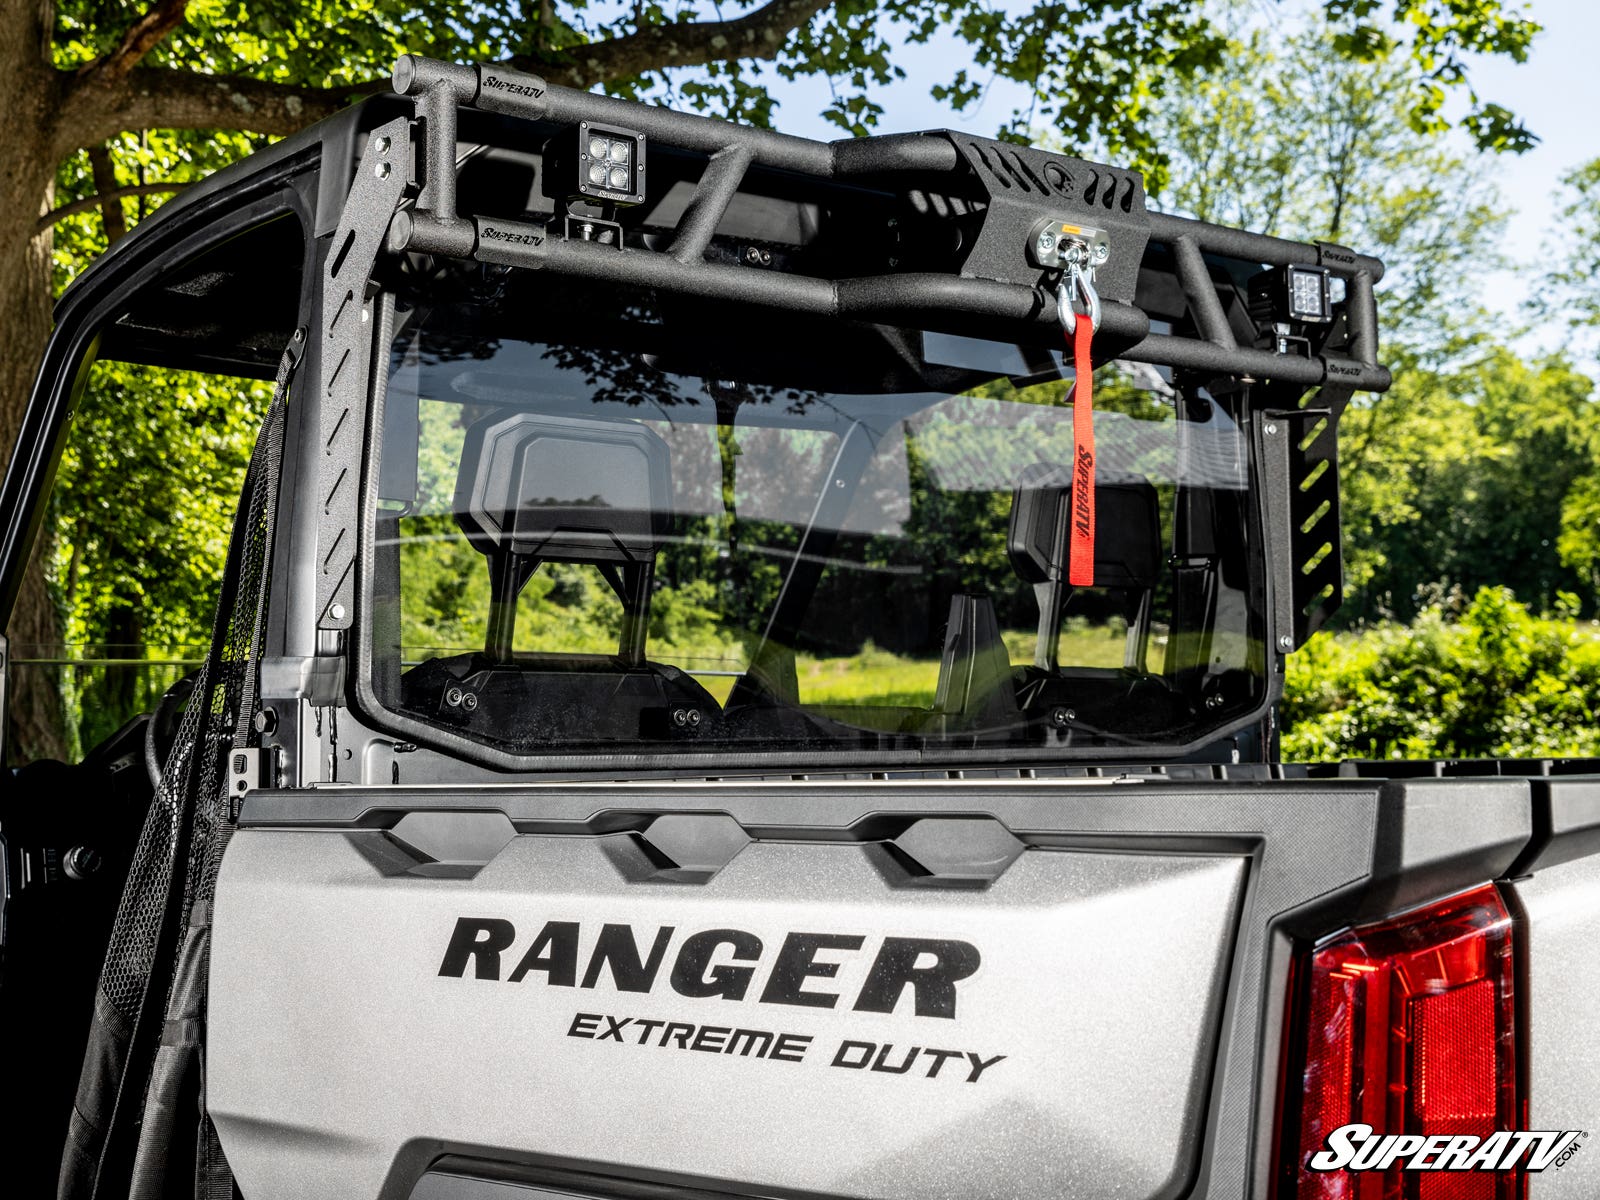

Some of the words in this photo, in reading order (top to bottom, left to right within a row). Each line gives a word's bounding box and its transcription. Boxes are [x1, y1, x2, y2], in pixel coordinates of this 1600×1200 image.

[1075, 444, 1093, 537] SUPERATV
[437, 916, 982, 1020] RANGER
[566, 1012, 815, 1063] EXTREME
[830, 1040, 1008, 1083] DUTY
